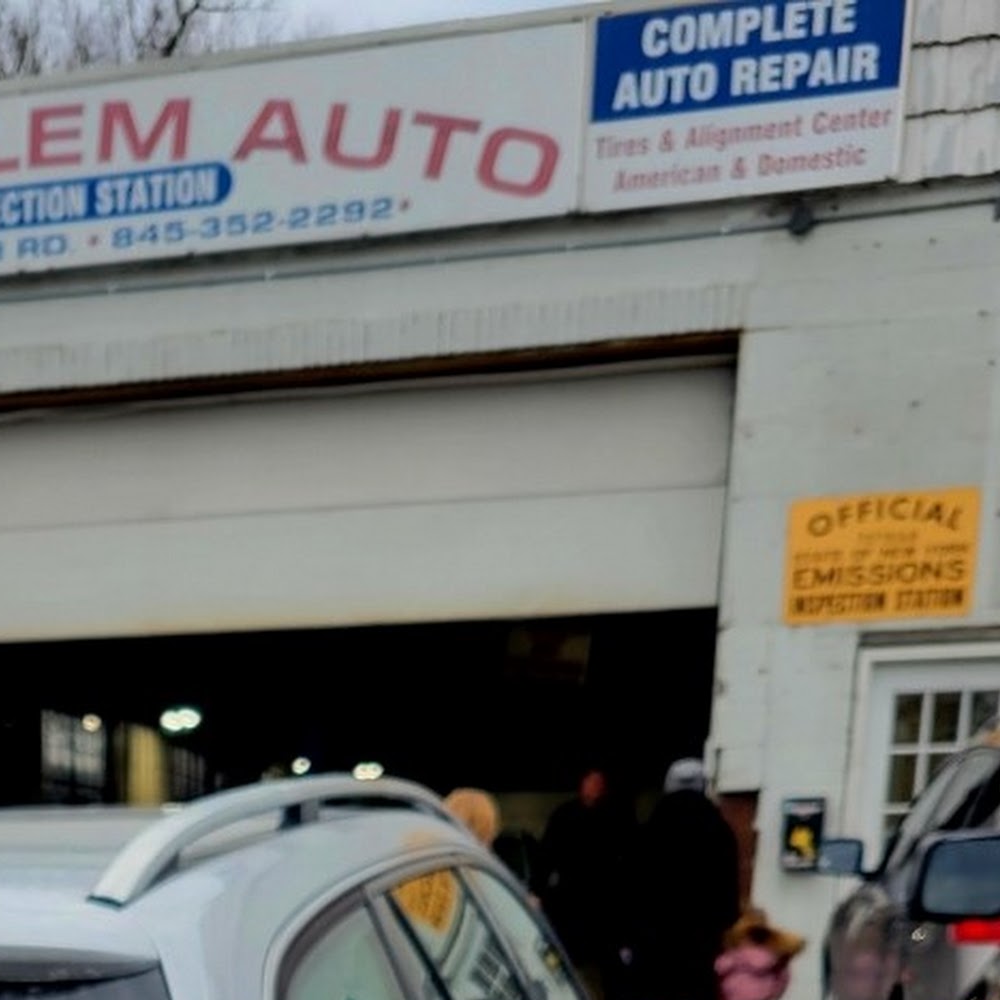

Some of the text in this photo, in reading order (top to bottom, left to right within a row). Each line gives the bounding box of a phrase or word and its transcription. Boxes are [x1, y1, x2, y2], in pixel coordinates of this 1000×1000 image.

[642, 0, 857, 57] COMPLETE
[613, 44, 879, 111] AUTO REPAIR
[231, 98, 562, 198] AUTO
[595, 106, 893, 161] Tires & Alignment Center
[94, 167, 219, 219] STATION
[613, 144, 867, 193] American & Domestic
[112, 197, 394, 249] 845-352-2292
[806, 497, 963, 538] OFFICIAL
[792, 560, 965, 590] EMISSIONS
